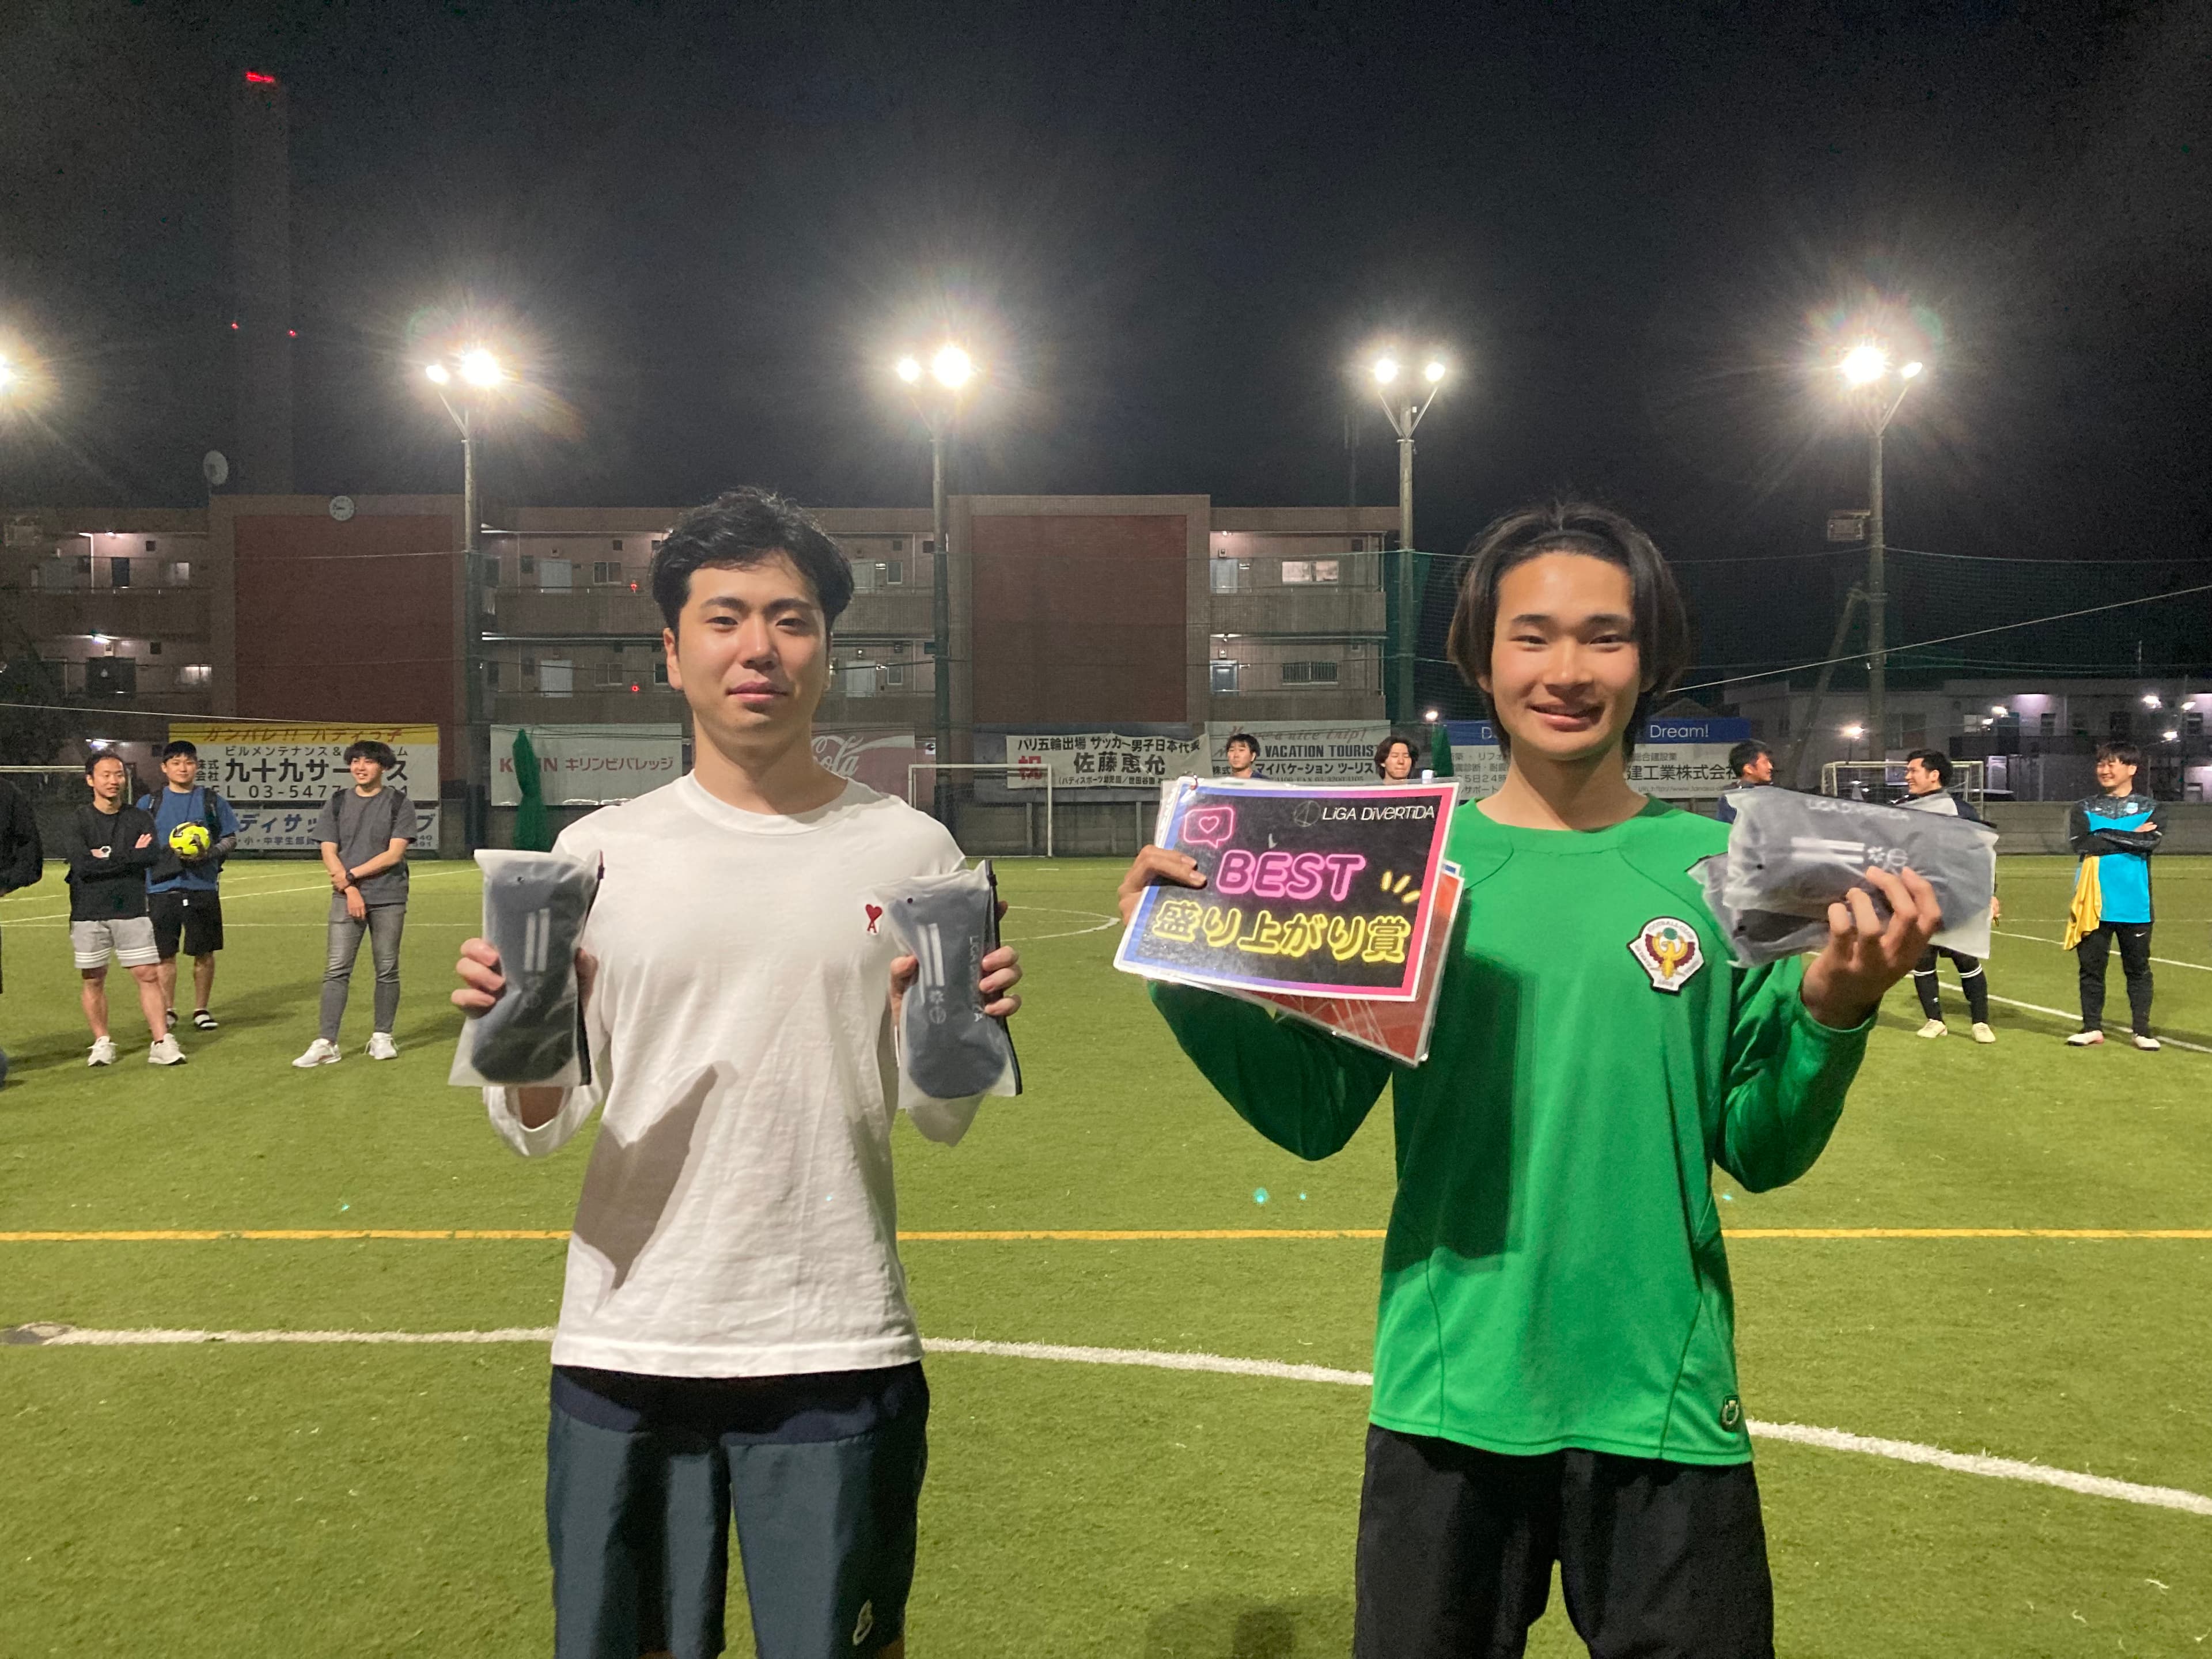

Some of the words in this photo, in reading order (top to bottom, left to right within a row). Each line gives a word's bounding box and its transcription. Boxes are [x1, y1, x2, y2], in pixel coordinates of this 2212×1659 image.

[1650, 725, 1709, 738] Dream!
[225, 746, 408, 756] ビルメンテナンス&ム
[1265, 745, 1324, 757] VACATION
[1328, 745, 1378, 757] TOURIS
[225, 758, 408, 782] 九十九サース
[566, 756, 673, 771] キリンビバレッジ
[1213, 766, 1231, 775] 株式
[1338, 763, 1374, 774] ツーリス
[1217, 850, 1366, 902] BEST
[1152, 900, 1411, 964] 盛り上がり賞
